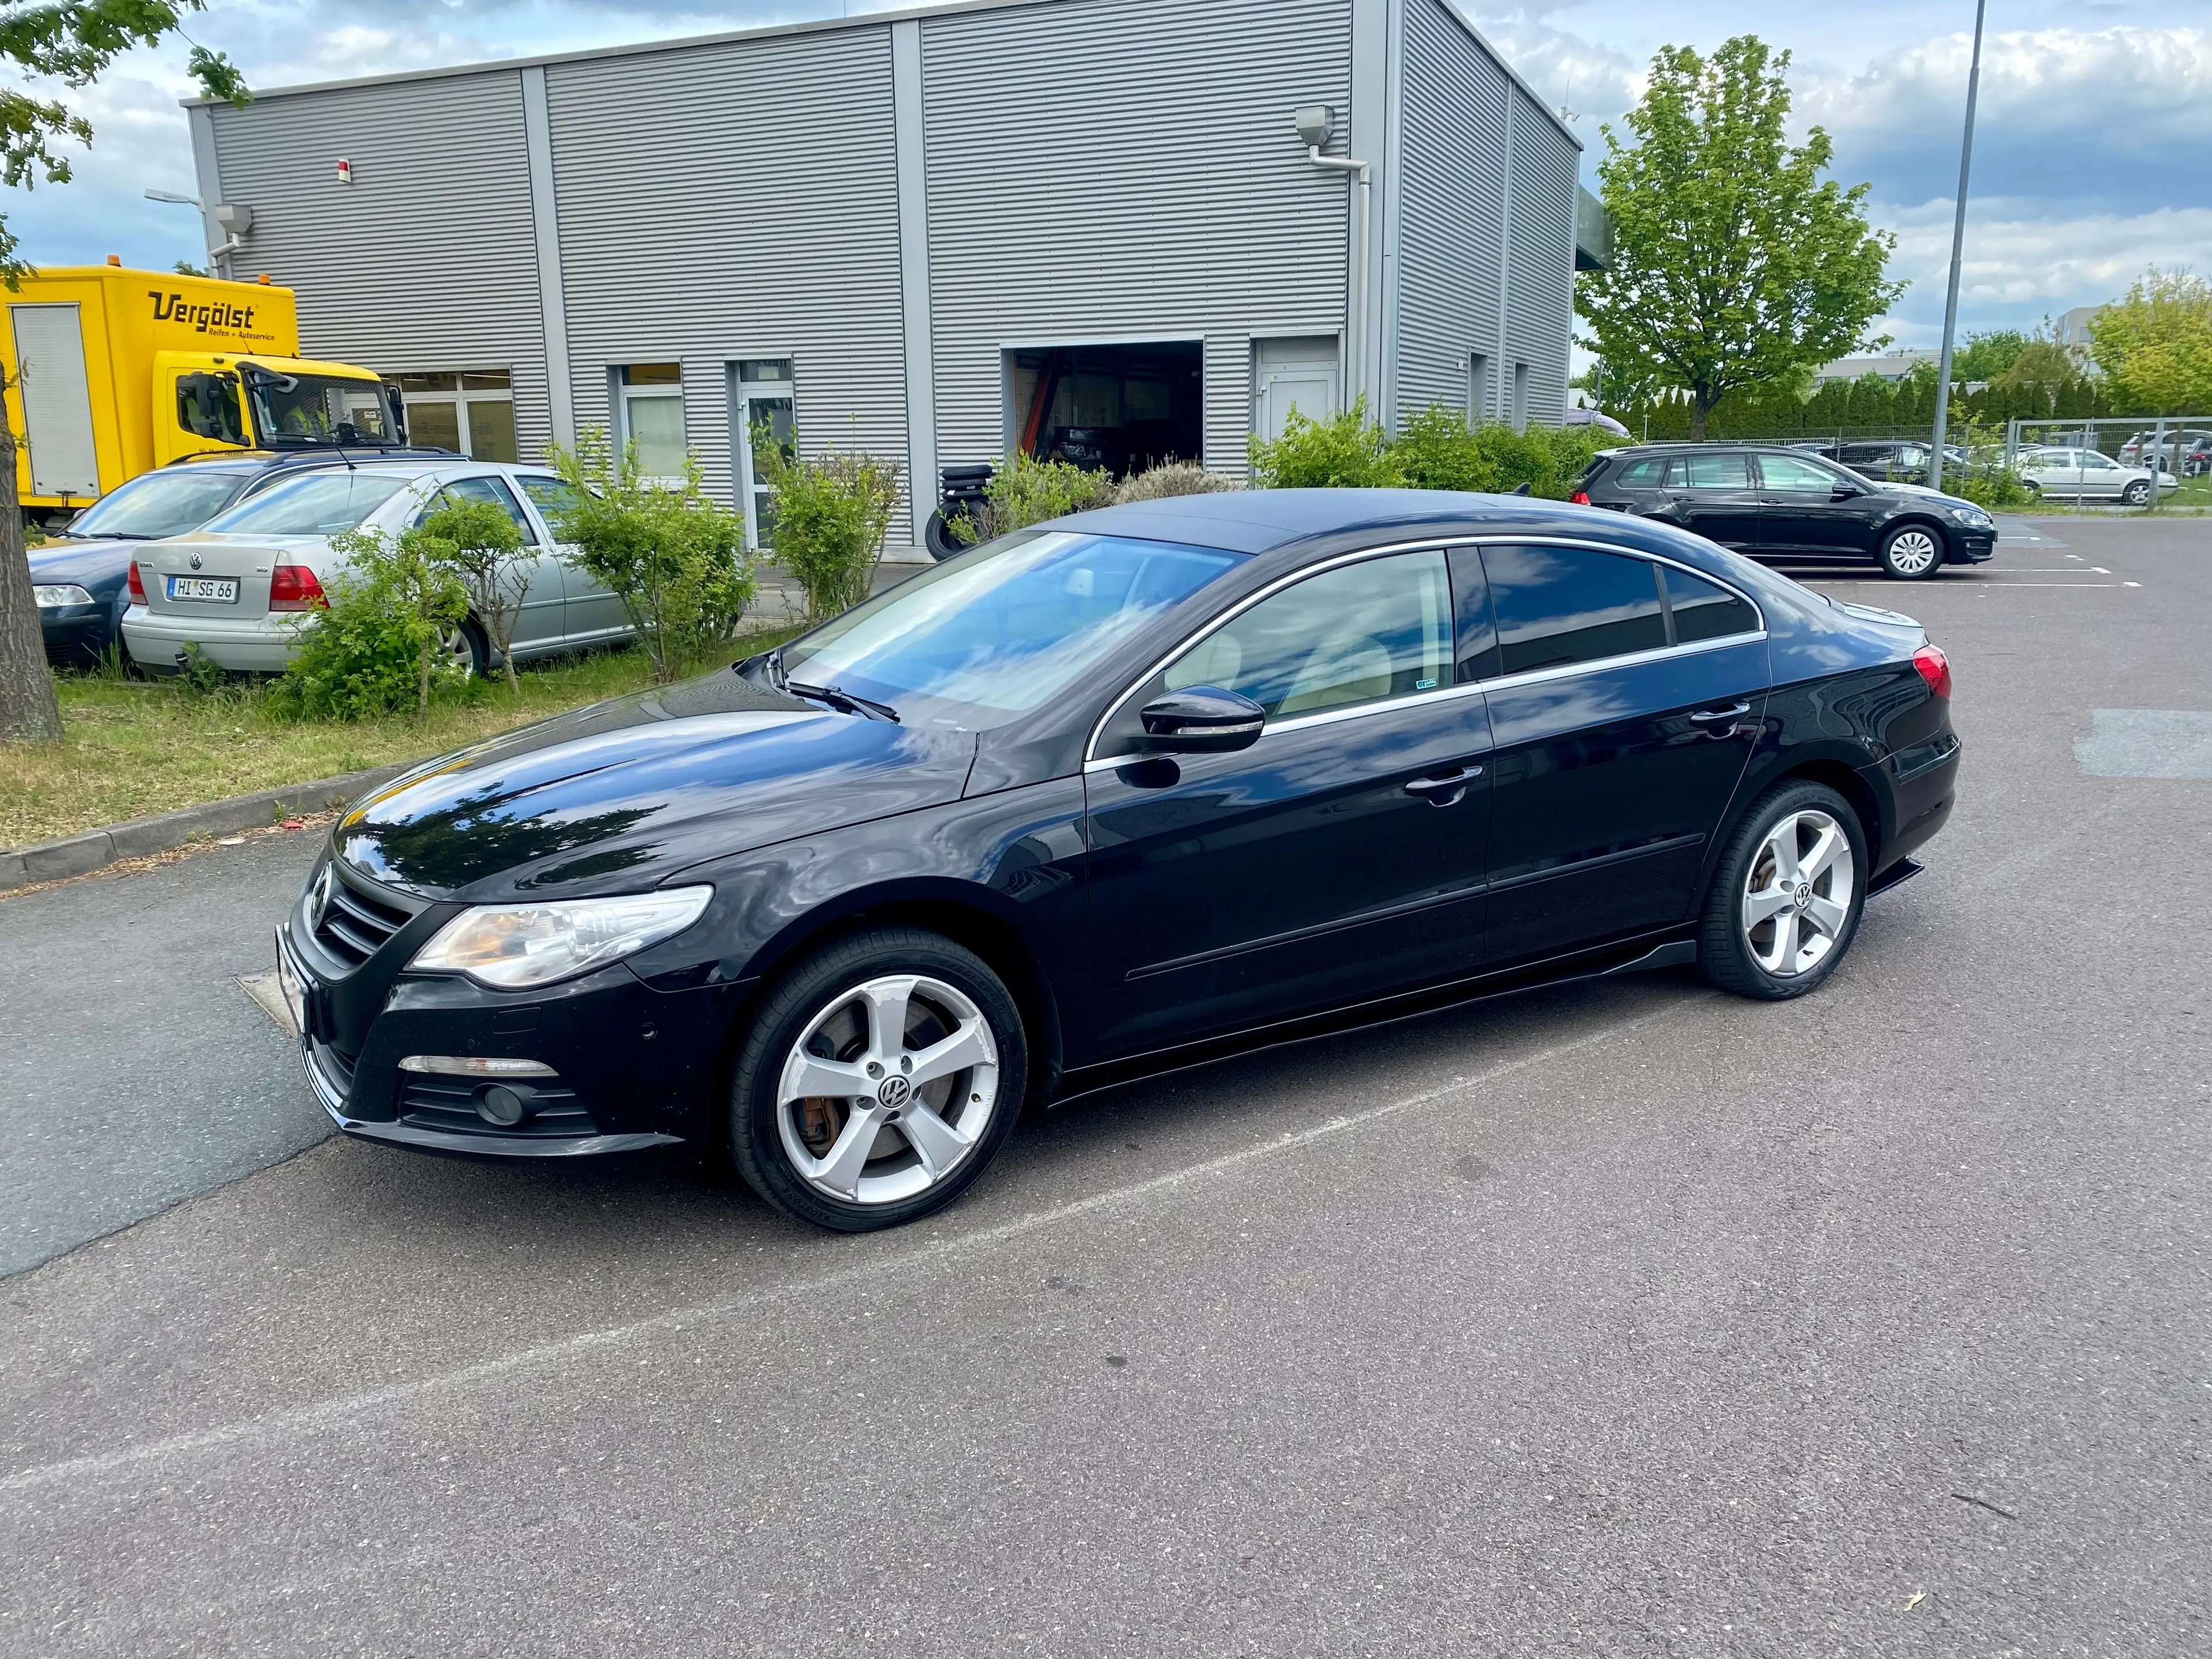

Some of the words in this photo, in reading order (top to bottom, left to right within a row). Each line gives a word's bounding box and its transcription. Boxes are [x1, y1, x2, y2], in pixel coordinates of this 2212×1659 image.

[147, 290, 254, 332] Vergölst
[209, 327, 229, 337] Reifen
[238, 330, 275, 341] Autoservice
[177, 580, 191, 595] HI
[198, 582, 213, 596] SG
[218, 583, 232, 597] 66
